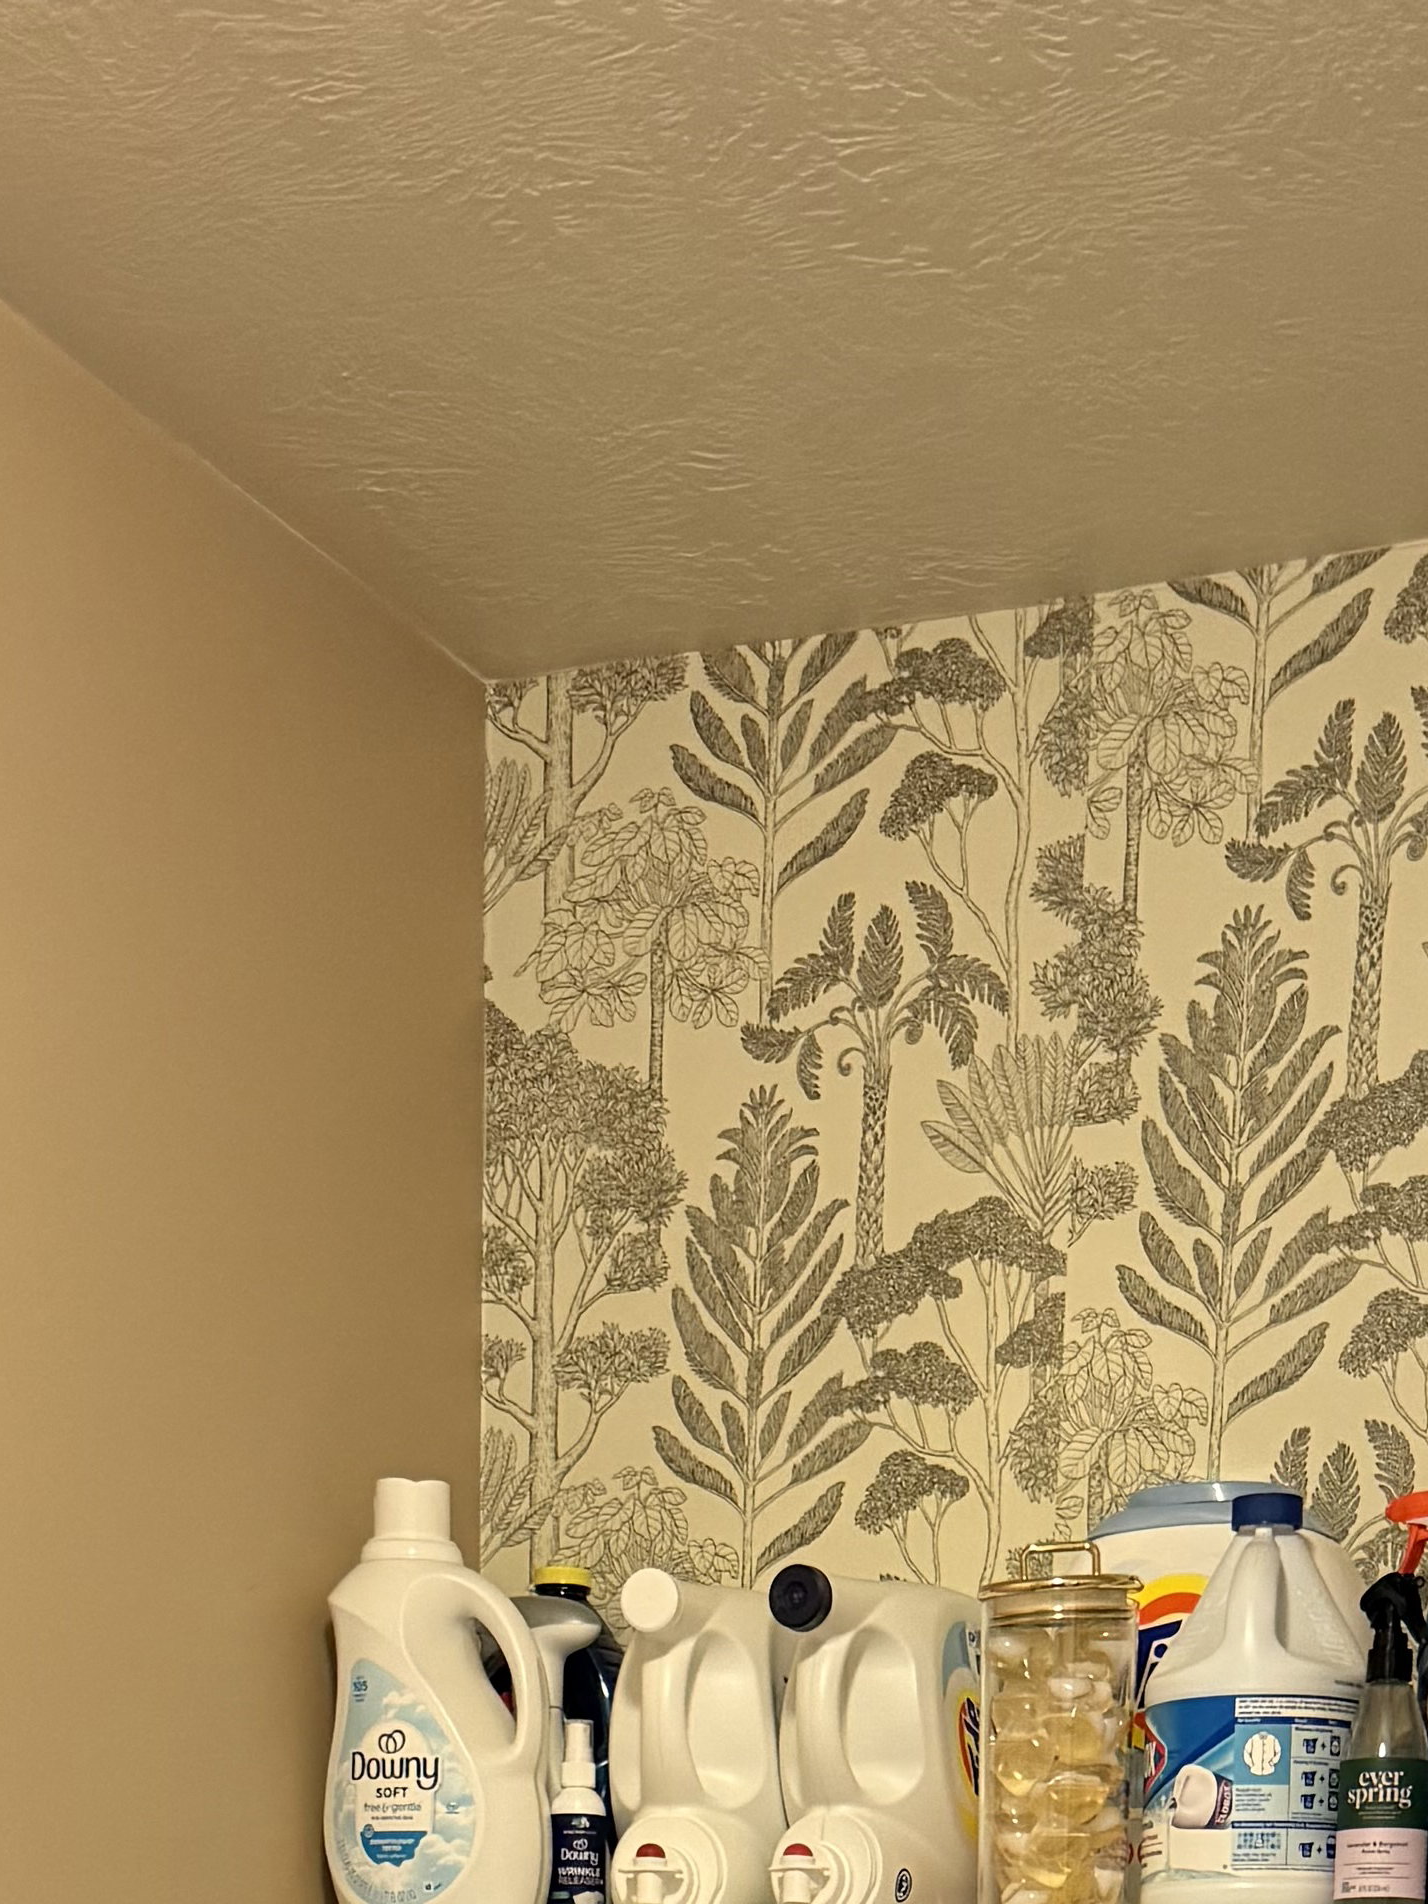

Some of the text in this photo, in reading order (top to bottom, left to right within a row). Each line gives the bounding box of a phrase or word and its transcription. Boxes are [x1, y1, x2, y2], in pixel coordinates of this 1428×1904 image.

[351, 1751, 440, 1791] Downy
[1358, 1770, 1405, 1787] ever
[376, 1787, 408, 1799] SOFT
[1347, 1783, 1413, 1810] spring
[364, 1802, 381, 1813] free
[391, 1802, 422, 1814] gentle
[560, 1848, 599, 1866] Downy
[558, 1866, 600, 1878] WRINKLE
